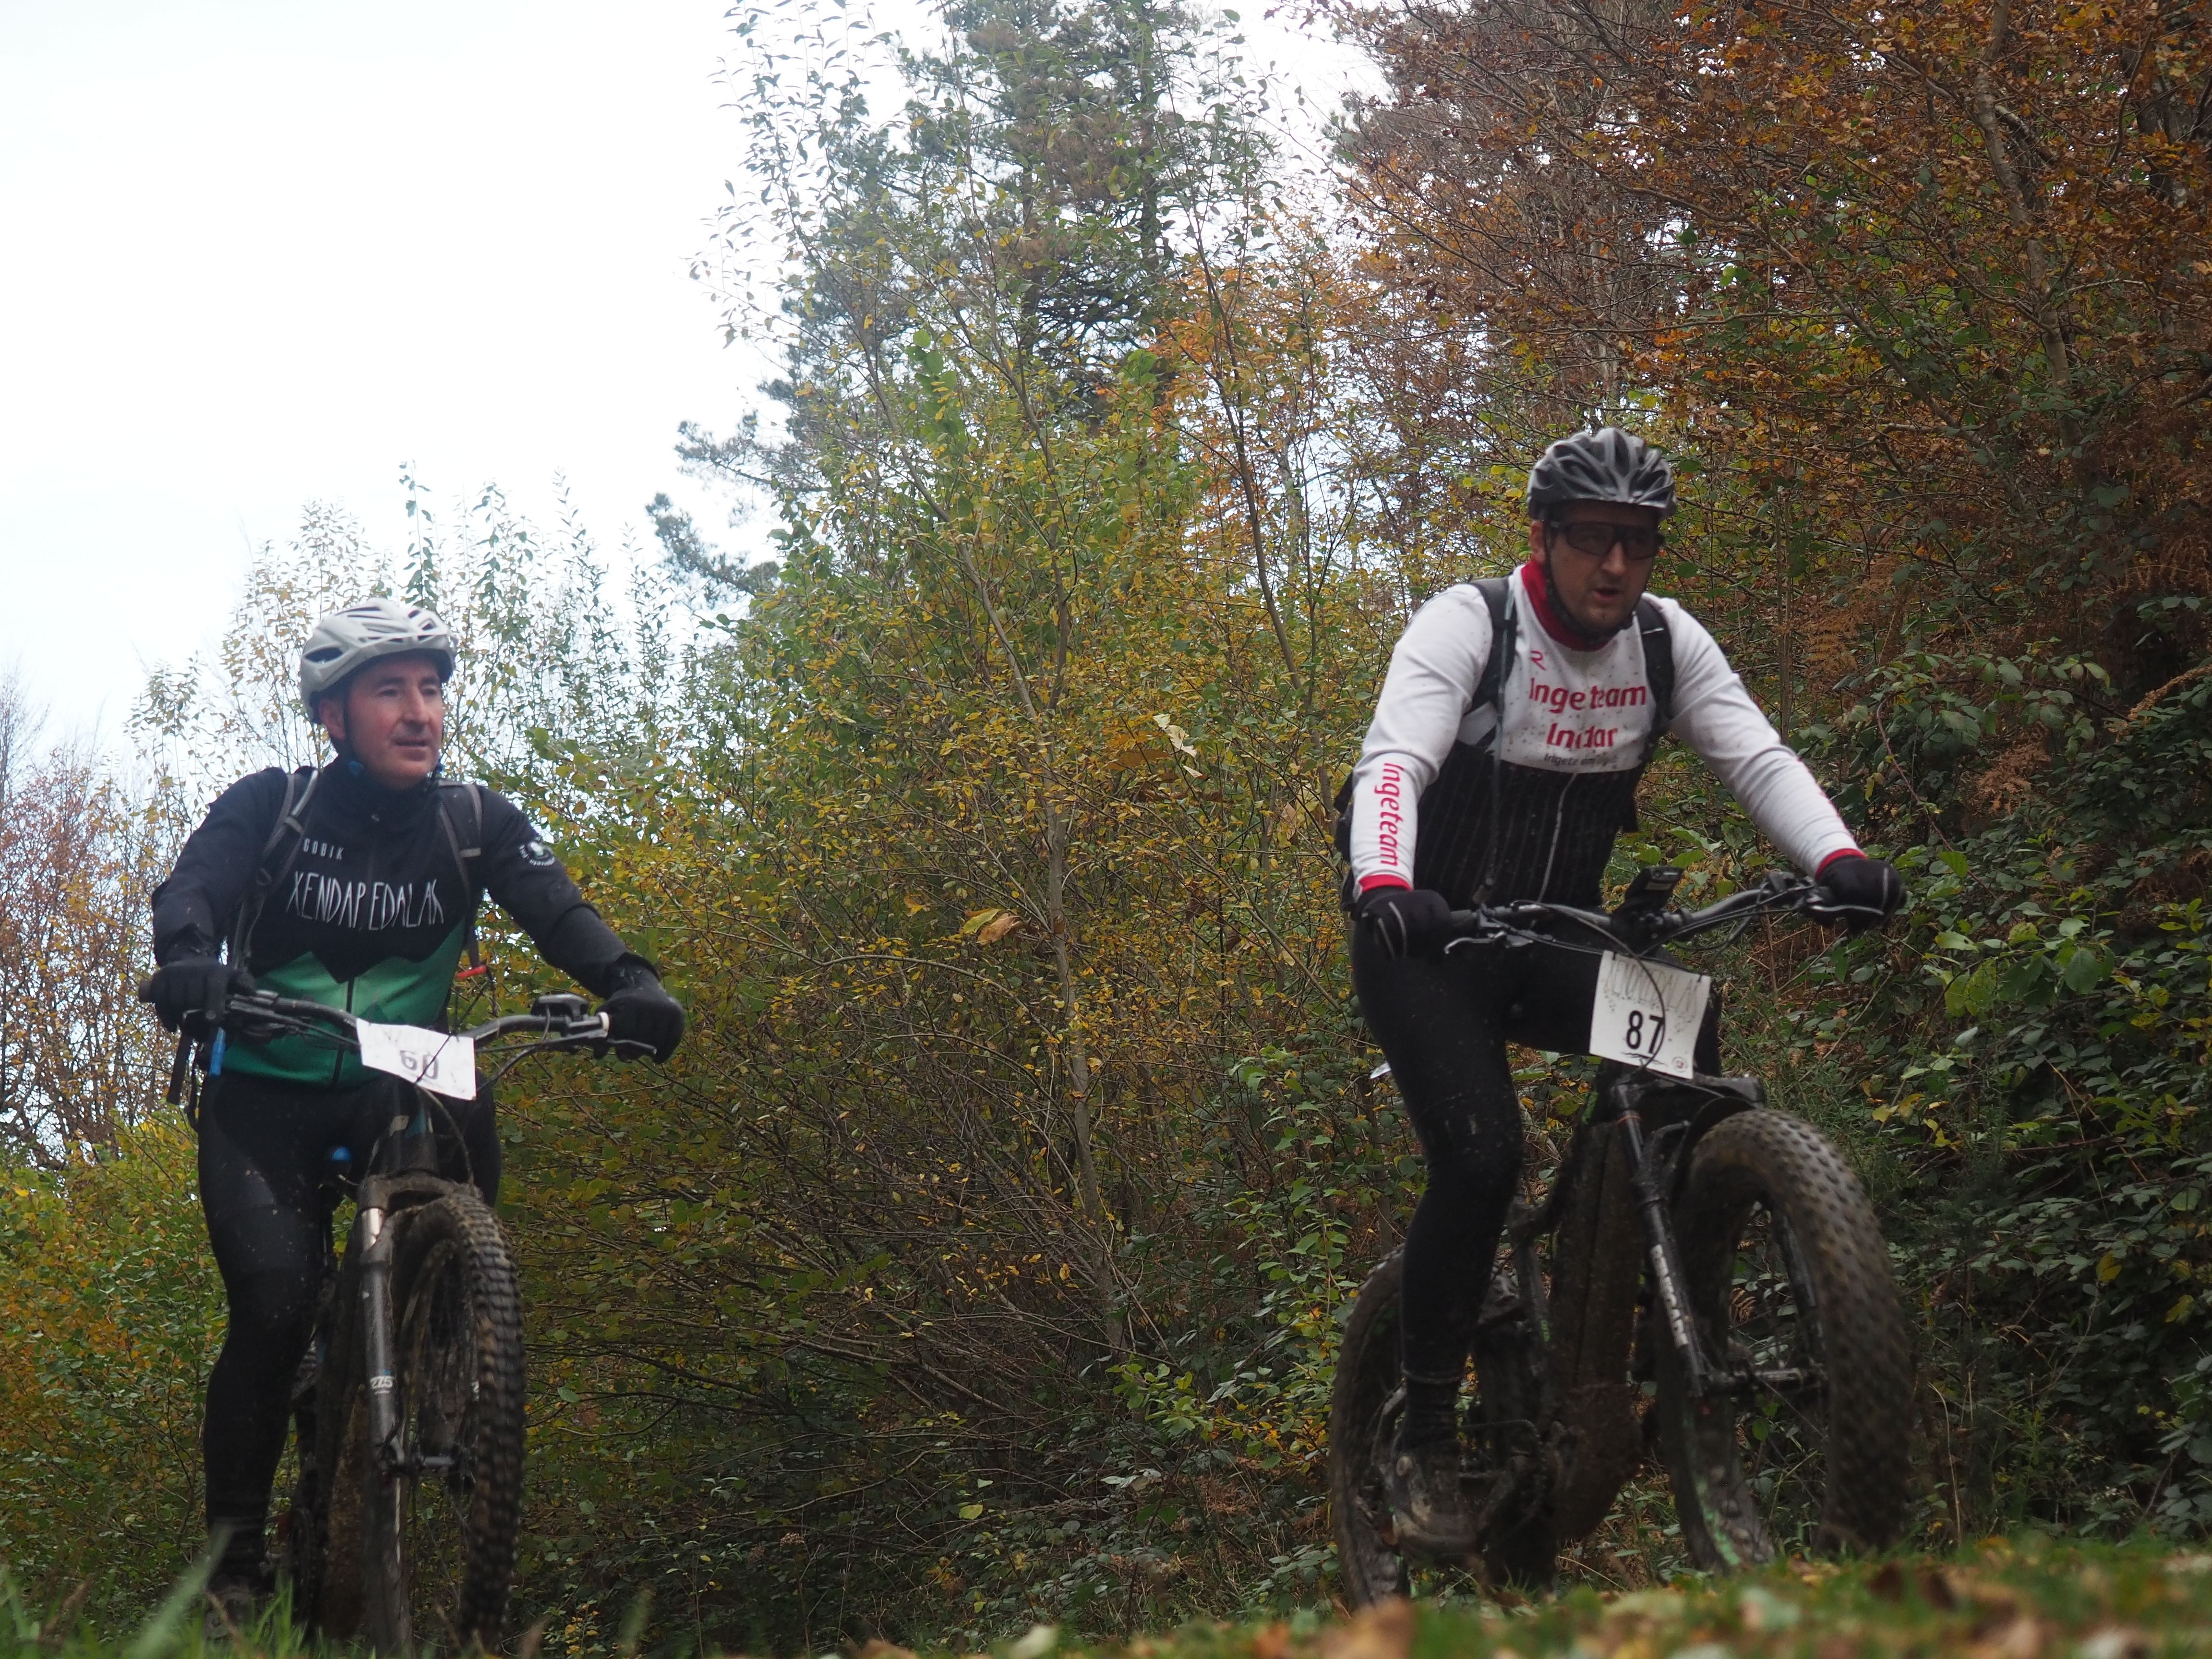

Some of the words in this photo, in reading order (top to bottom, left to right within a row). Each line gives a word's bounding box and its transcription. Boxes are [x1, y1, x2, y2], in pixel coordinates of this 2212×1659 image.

[1374, 762, 1405, 866] Ingeteam
[302, 838, 344, 860] GOBIK
[285, 870, 444, 931] XENDAPEDALAK
[1625, 1010, 1665, 1054] 87
